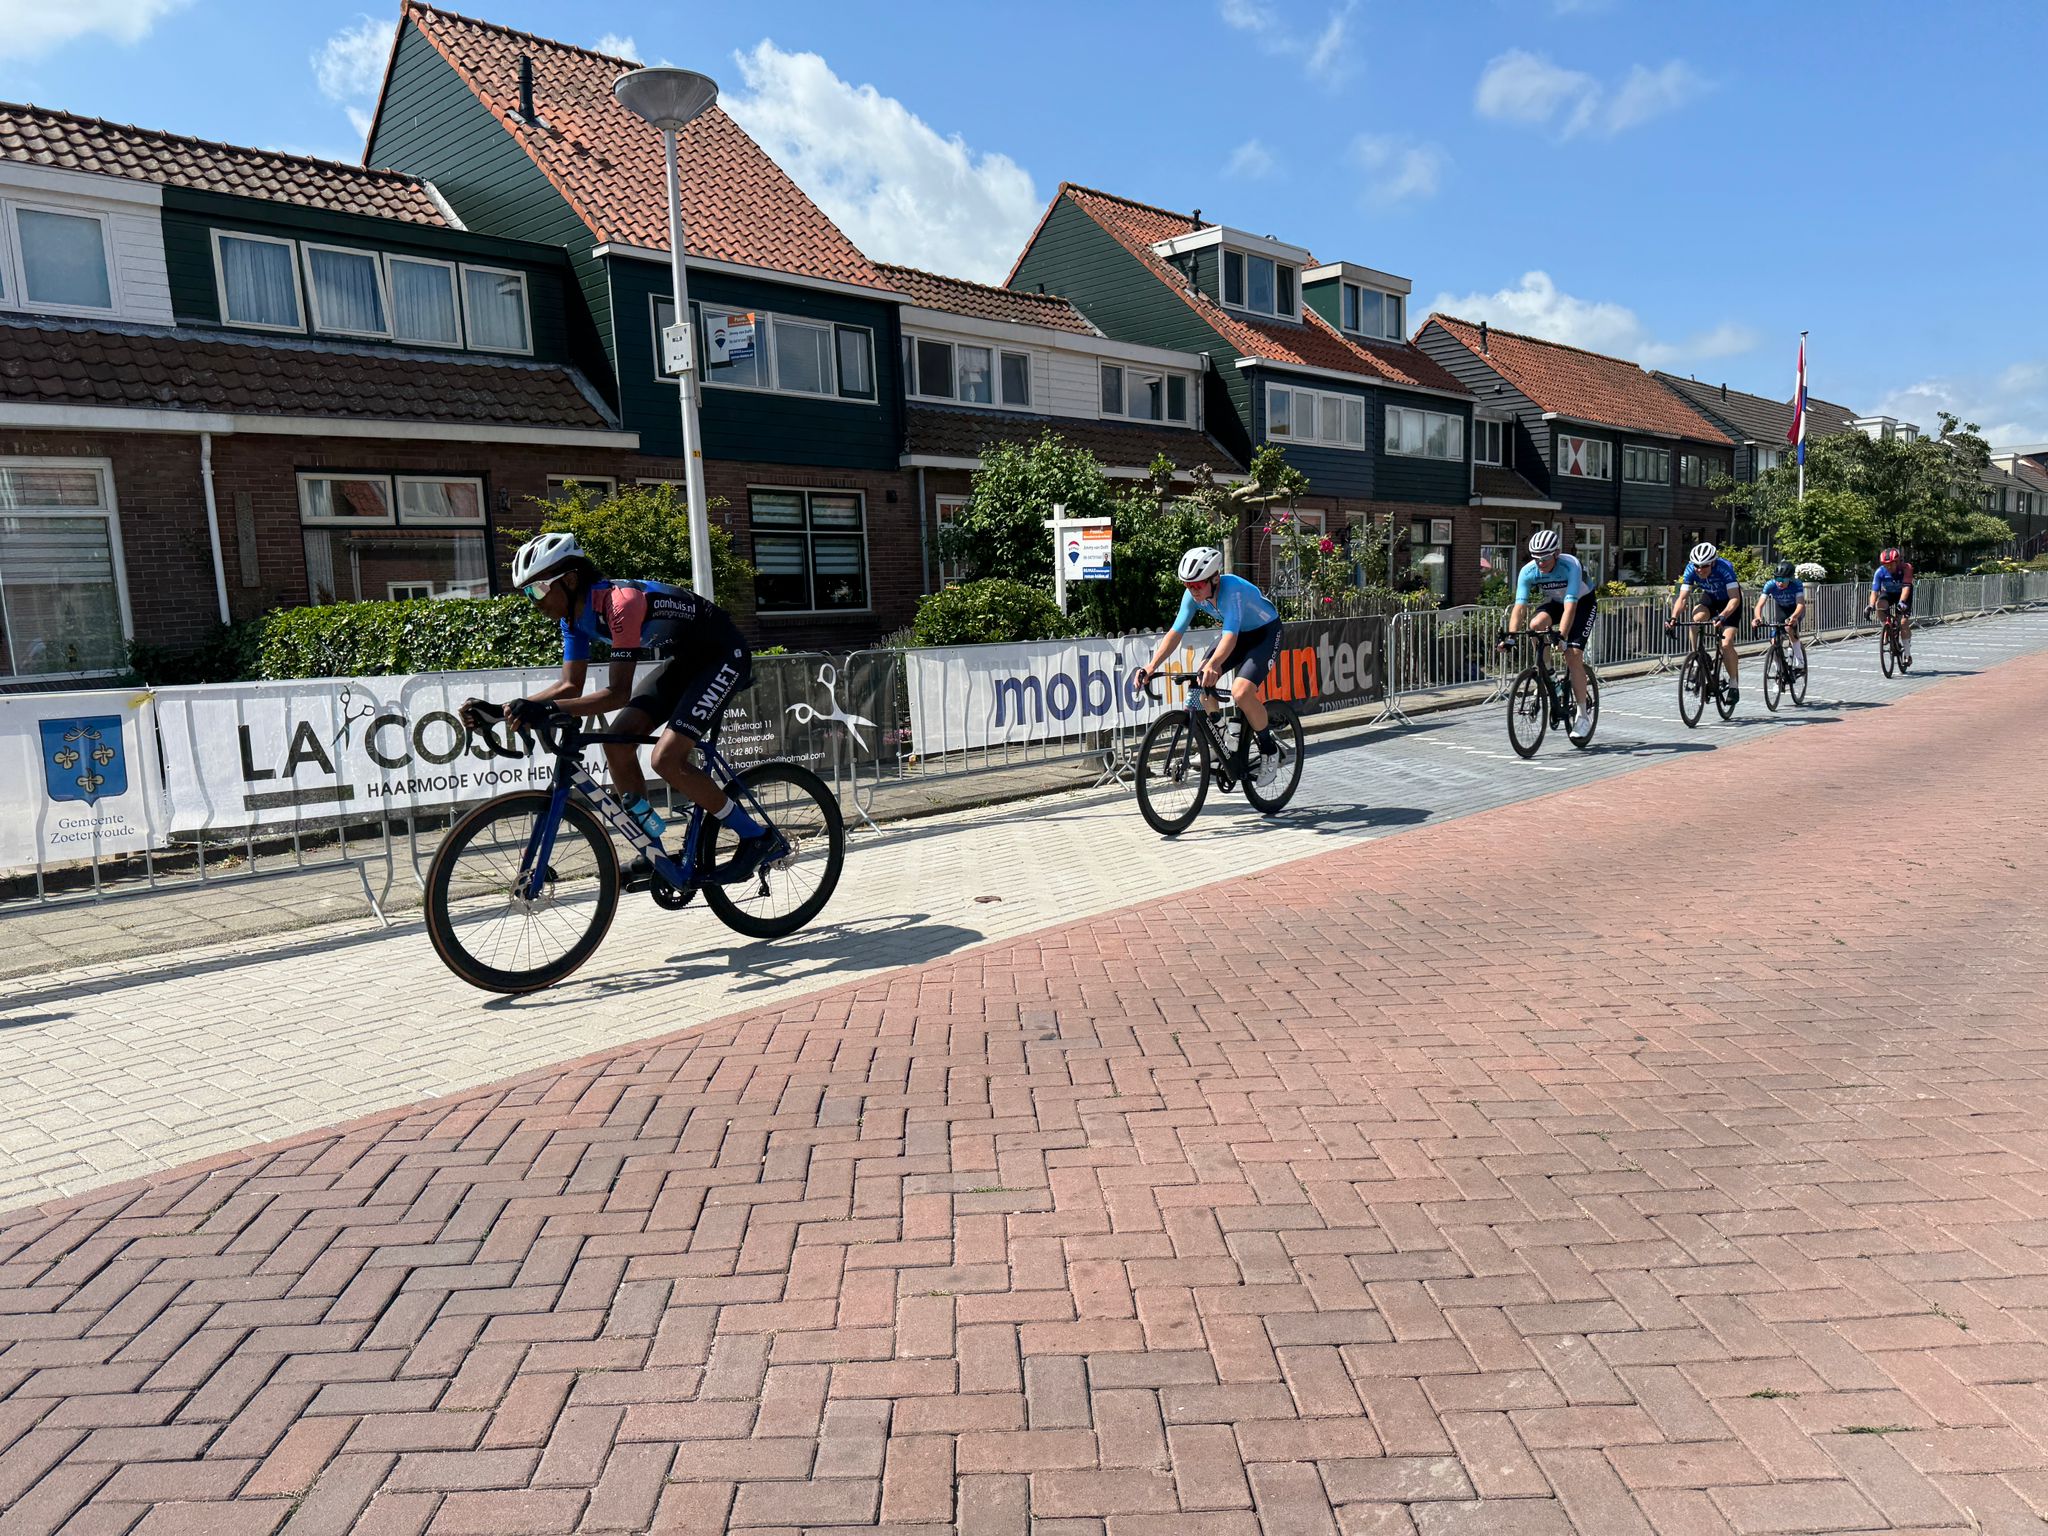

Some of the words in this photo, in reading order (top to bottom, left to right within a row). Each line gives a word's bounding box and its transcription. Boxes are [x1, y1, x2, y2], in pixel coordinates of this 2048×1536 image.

[653, 598, 696, 614] aanhuis.nl
[1582, 605, 1597, 638] GARMIN
[1256, 632, 1373, 703] untec
[691, 663, 738, 721] SWIFT
[723, 708, 747, 719] SIMA
[238, 720, 337, 782] LA
[727, 732, 775, 745] Zoeterwoude
[730, 748, 743, 756] 542
[744, 747, 754, 755] 80
[1206, 719, 1231, 760] cannondale
[367, 773, 469, 799] HAARMODE
[473, 768, 523, 788] VOOR
[58, 814, 124, 829] Gemeente
[571, 761, 668, 865] TREK
[49, 825, 135, 844] Zoeterwoude
